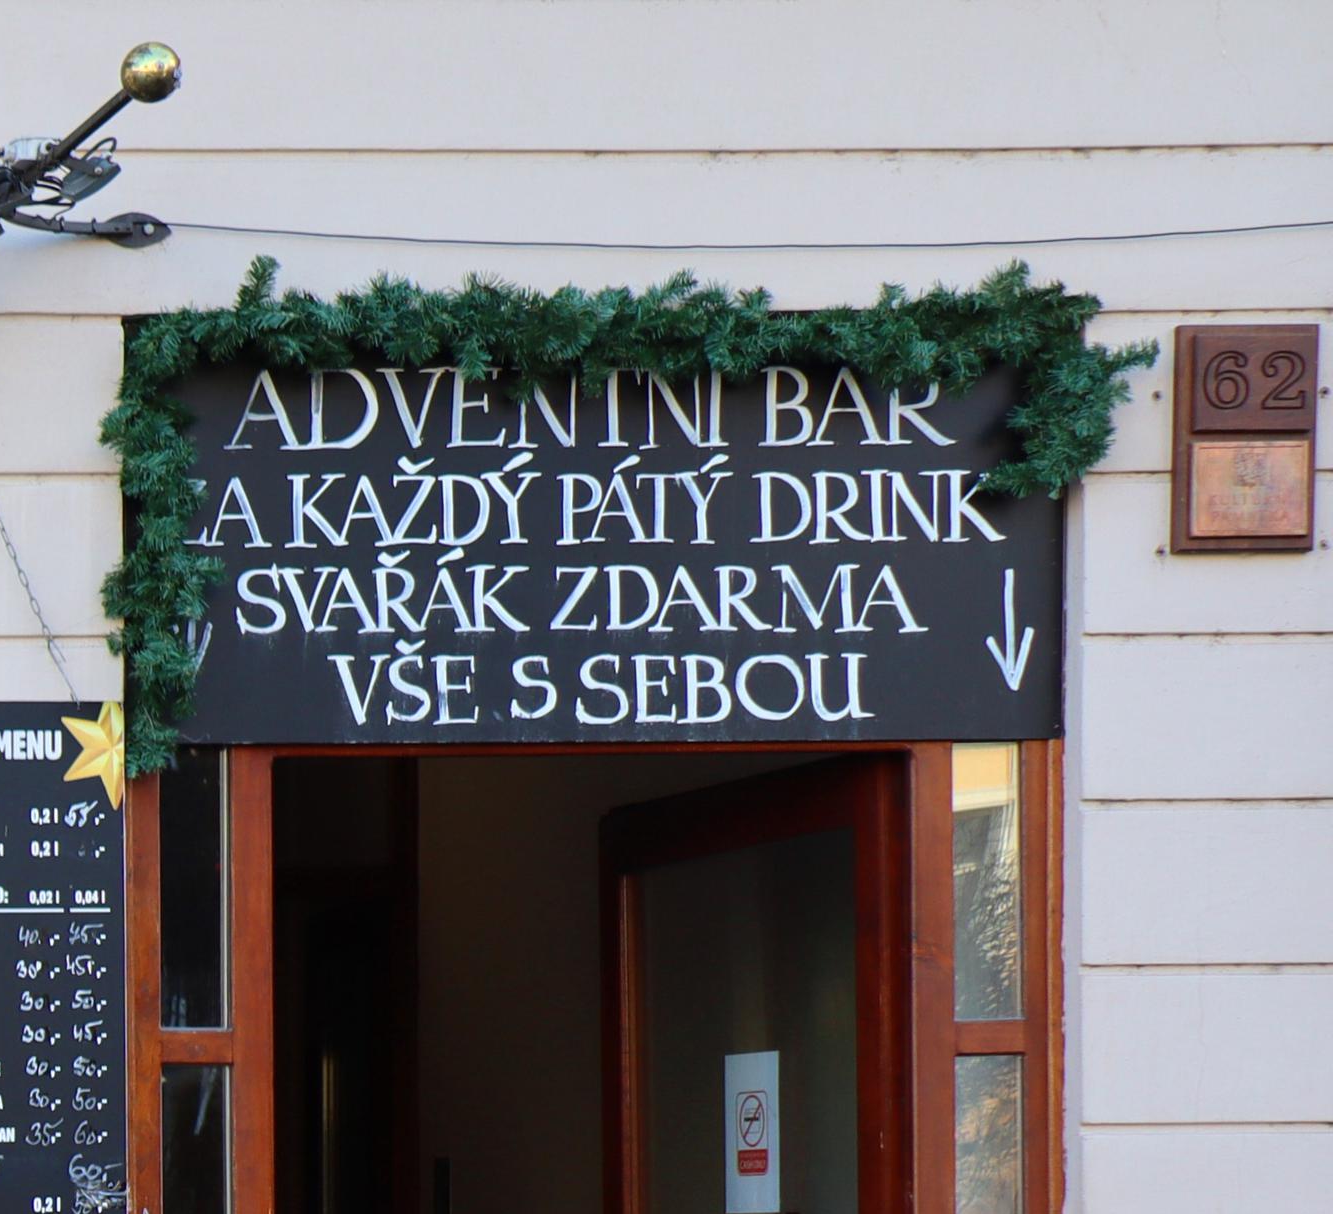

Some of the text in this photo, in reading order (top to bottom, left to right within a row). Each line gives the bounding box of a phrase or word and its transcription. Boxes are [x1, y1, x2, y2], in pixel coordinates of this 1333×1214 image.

[758, 365, 956, 449] BAR
[1203, 351, 1306, 410] 62
[286, 451, 541, 549] KAŽDÝ
[555, 452, 732, 547] PÁTÝ
[748, 468, 1008, 544] DRINK
[235, 549, 929, 635] SVAŘÁK ZDARMA
[329, 639, 875, 726] VŠE S SEBOU
[31, 808, 51, 825] 0,2
[31, 840, 51, 858] 0,2
[29, 890, 54, 905] 0,02
[74, 890, 99, 905] 0,04
[34, 1196, 54, 1213] 0,2
